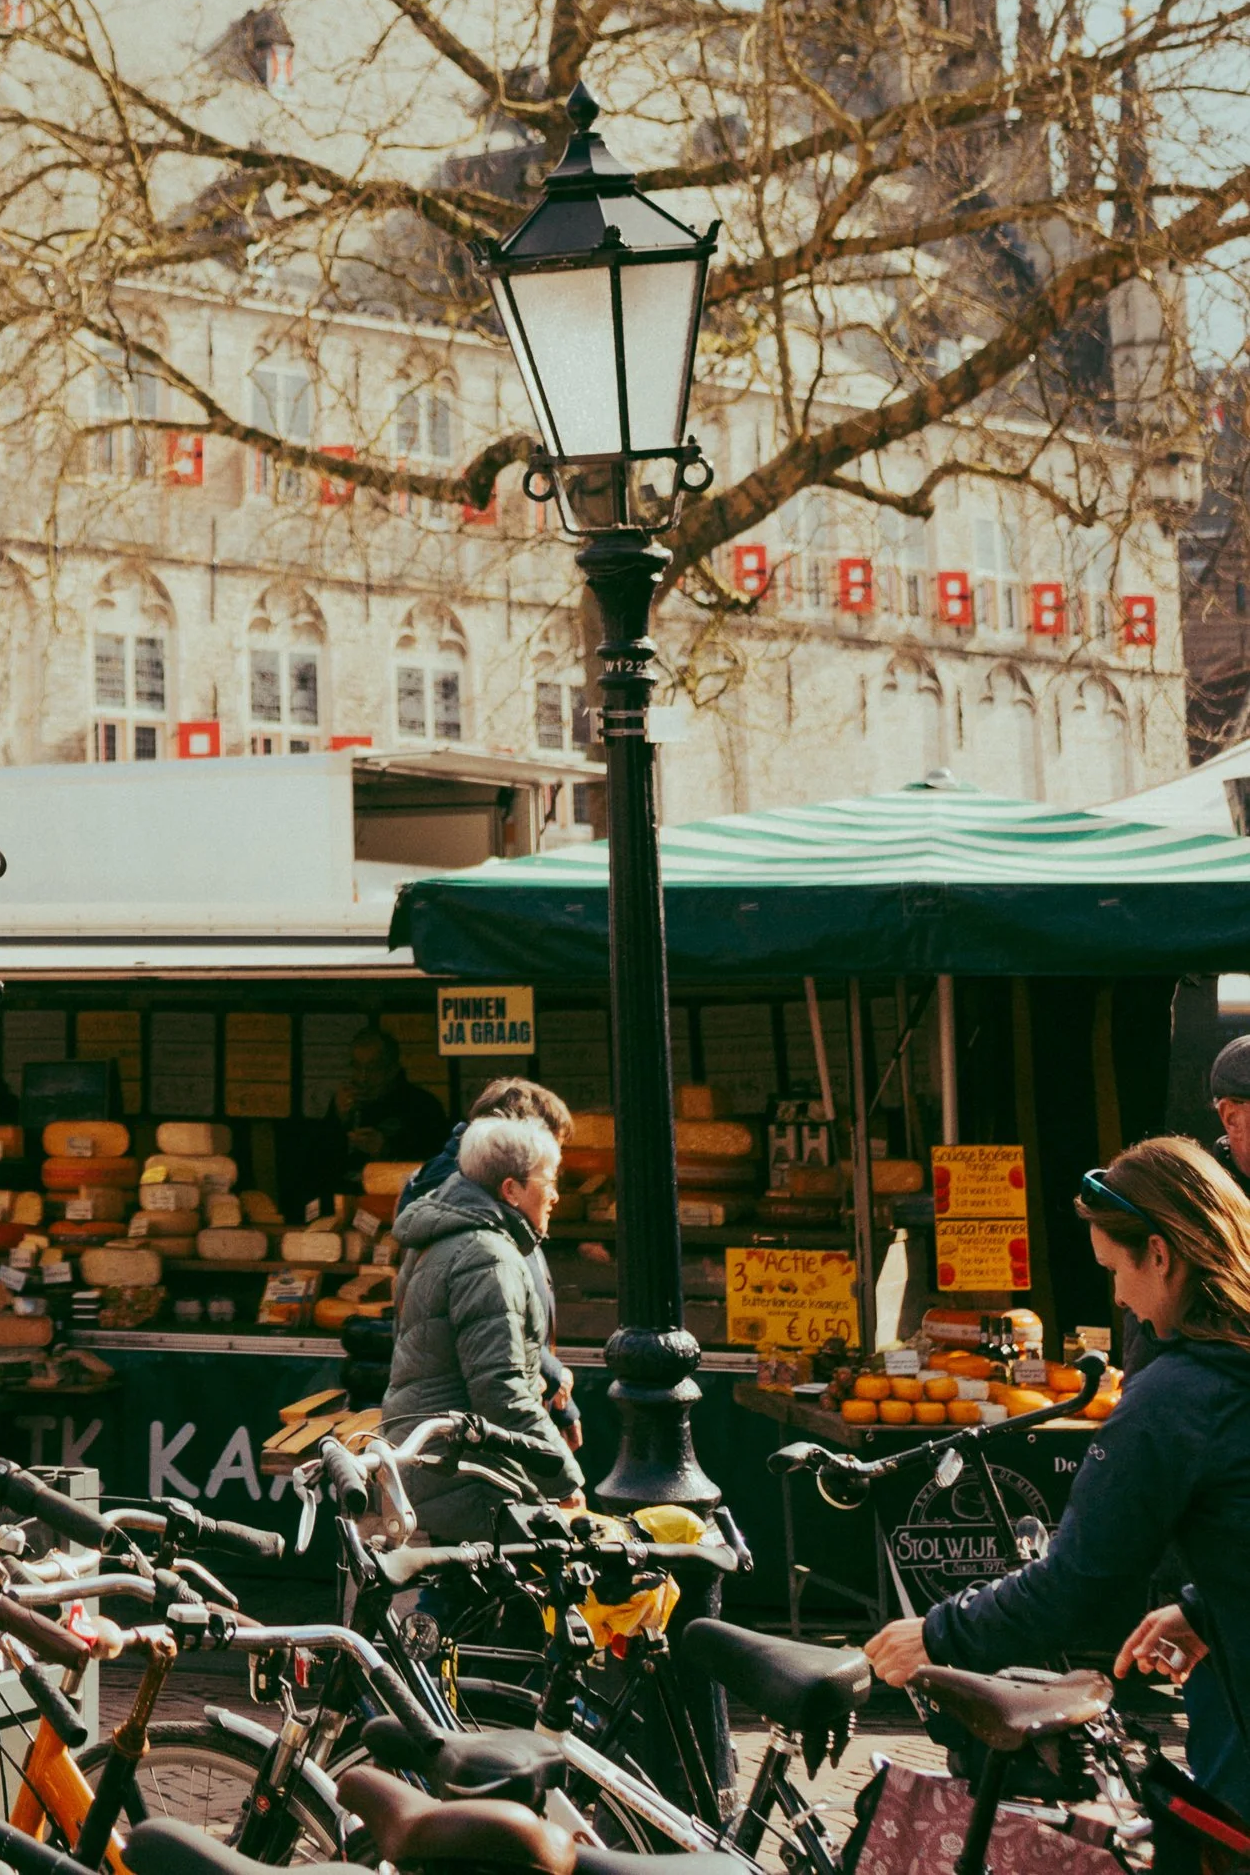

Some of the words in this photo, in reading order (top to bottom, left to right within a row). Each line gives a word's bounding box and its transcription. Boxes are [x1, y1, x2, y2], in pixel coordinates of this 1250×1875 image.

[442, 997, 506, 1020] PINNEN
[442, 1021, 466, 1044] JA
[471, 1021, 530, 1044] GRAAG
[733, 1262, 748, 1293] 3
[896, 1532, 998, 1561] STOLWIJK
